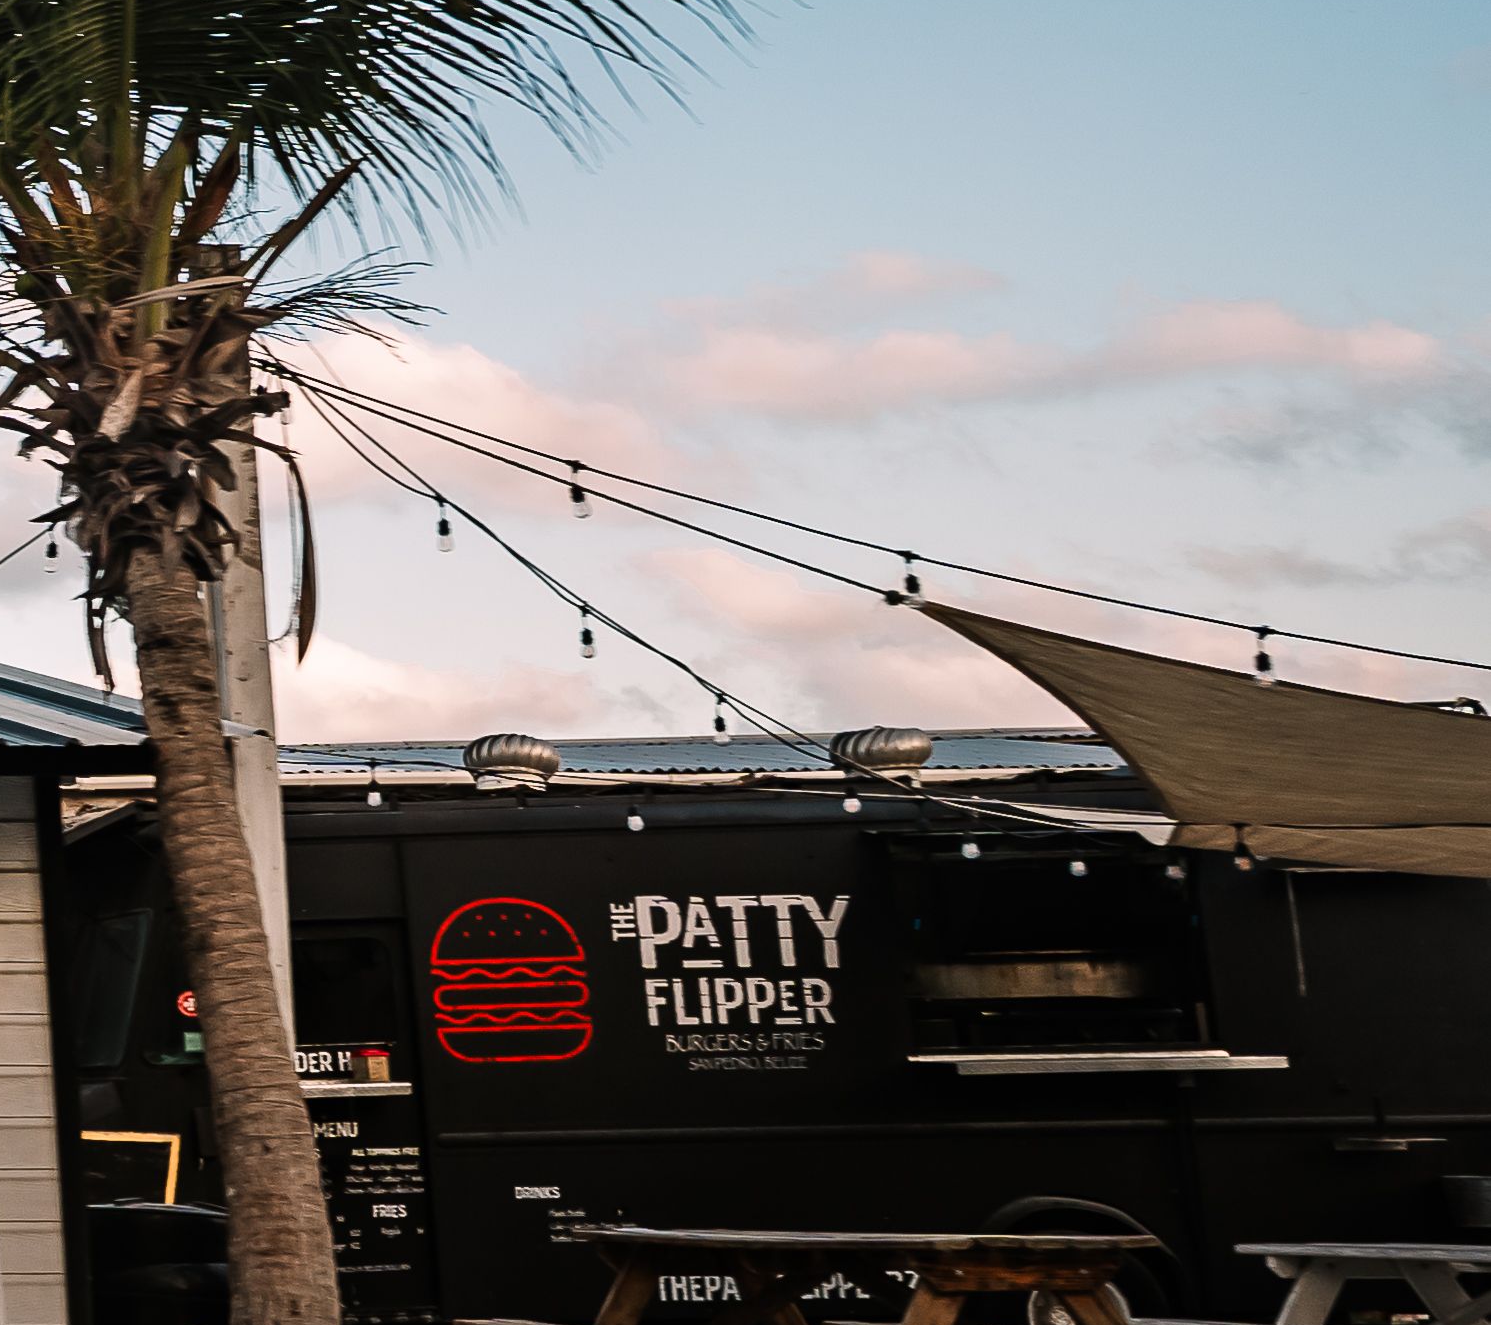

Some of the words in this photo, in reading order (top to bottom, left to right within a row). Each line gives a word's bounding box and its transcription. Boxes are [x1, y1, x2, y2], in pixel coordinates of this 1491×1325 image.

[610, 903, 636, 942] THE
[635, 894, 851, 969] PATTY
[645, 977, 836, 1026] FLIPPER
[665, 1033, 753, 1052] BURGERS
[756, 1033, 770, 1051] &
[772, 1032, 825, 1050] FRIES
[294, 1051, 333, 1073] DER
[314, 1122, 359, 1138] MENU
[372, 1204, 408, 1219] FRIES
